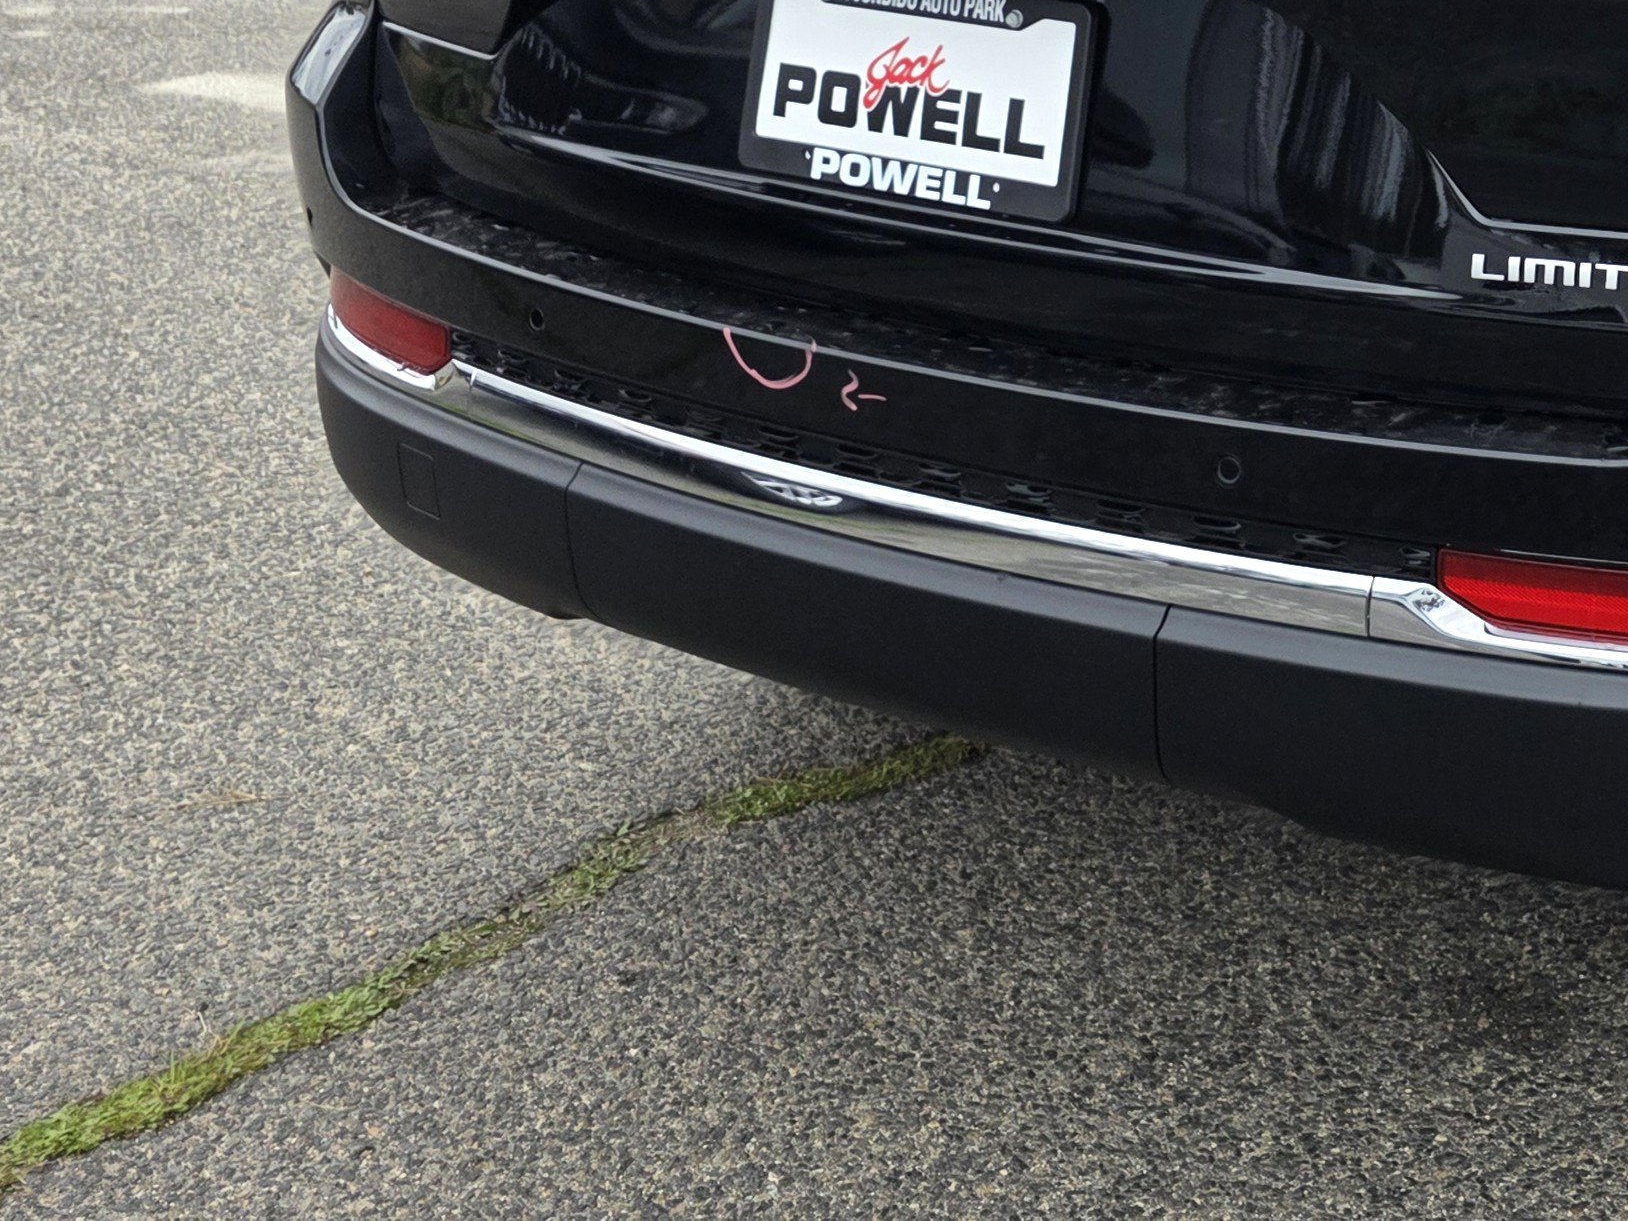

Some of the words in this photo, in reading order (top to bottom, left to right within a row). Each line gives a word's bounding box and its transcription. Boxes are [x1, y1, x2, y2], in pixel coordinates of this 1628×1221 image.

[862, 36, 949, 110] Jack
[772, 62, 1046, 160] POWELL
[809, 147, 992, 210] POWELL
